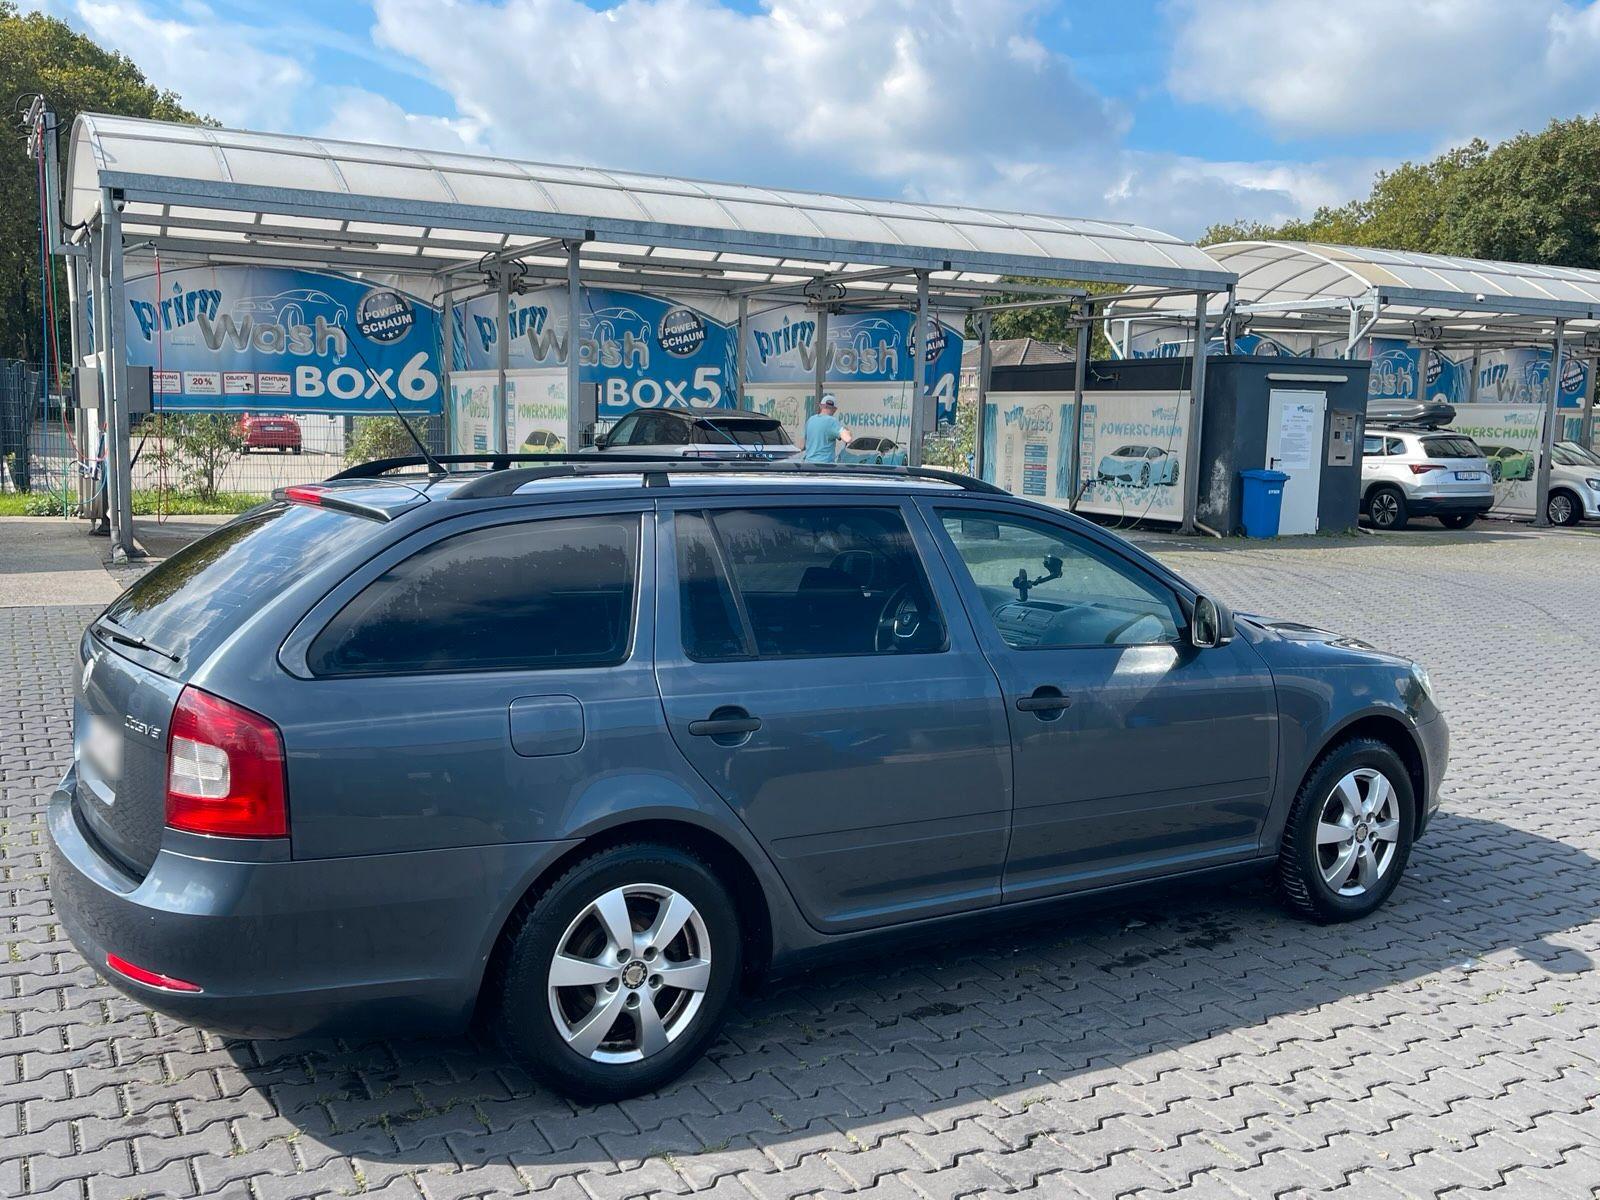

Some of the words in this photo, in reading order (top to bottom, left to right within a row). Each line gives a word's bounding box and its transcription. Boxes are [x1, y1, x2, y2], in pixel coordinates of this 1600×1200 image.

[130, 283, 222, 341] prim
[364, 304, 404, 321] POWER
[362, 313, 413, 335] SCHAUM
[474, 302, 548, 352] pim
[664, 320, 698, 336] POWER
[197, 314, 348, 357] Wash
[662, 329, 705, 348] SCHAUM
[754, 317, 815, 364] prim
[909, 339, 945, 356] SAUM
[192, 377, 203, 385] 20
[1368, 367, 1413, 396] ash
[1480, 362, 1509, 389] rim
[838, 412, 910, 429] POWERSCHAUM
[1101, 422, 1183, 438] POWERSCHAUM
[1454, 426, 1538, 439] OWERSCHAUM
